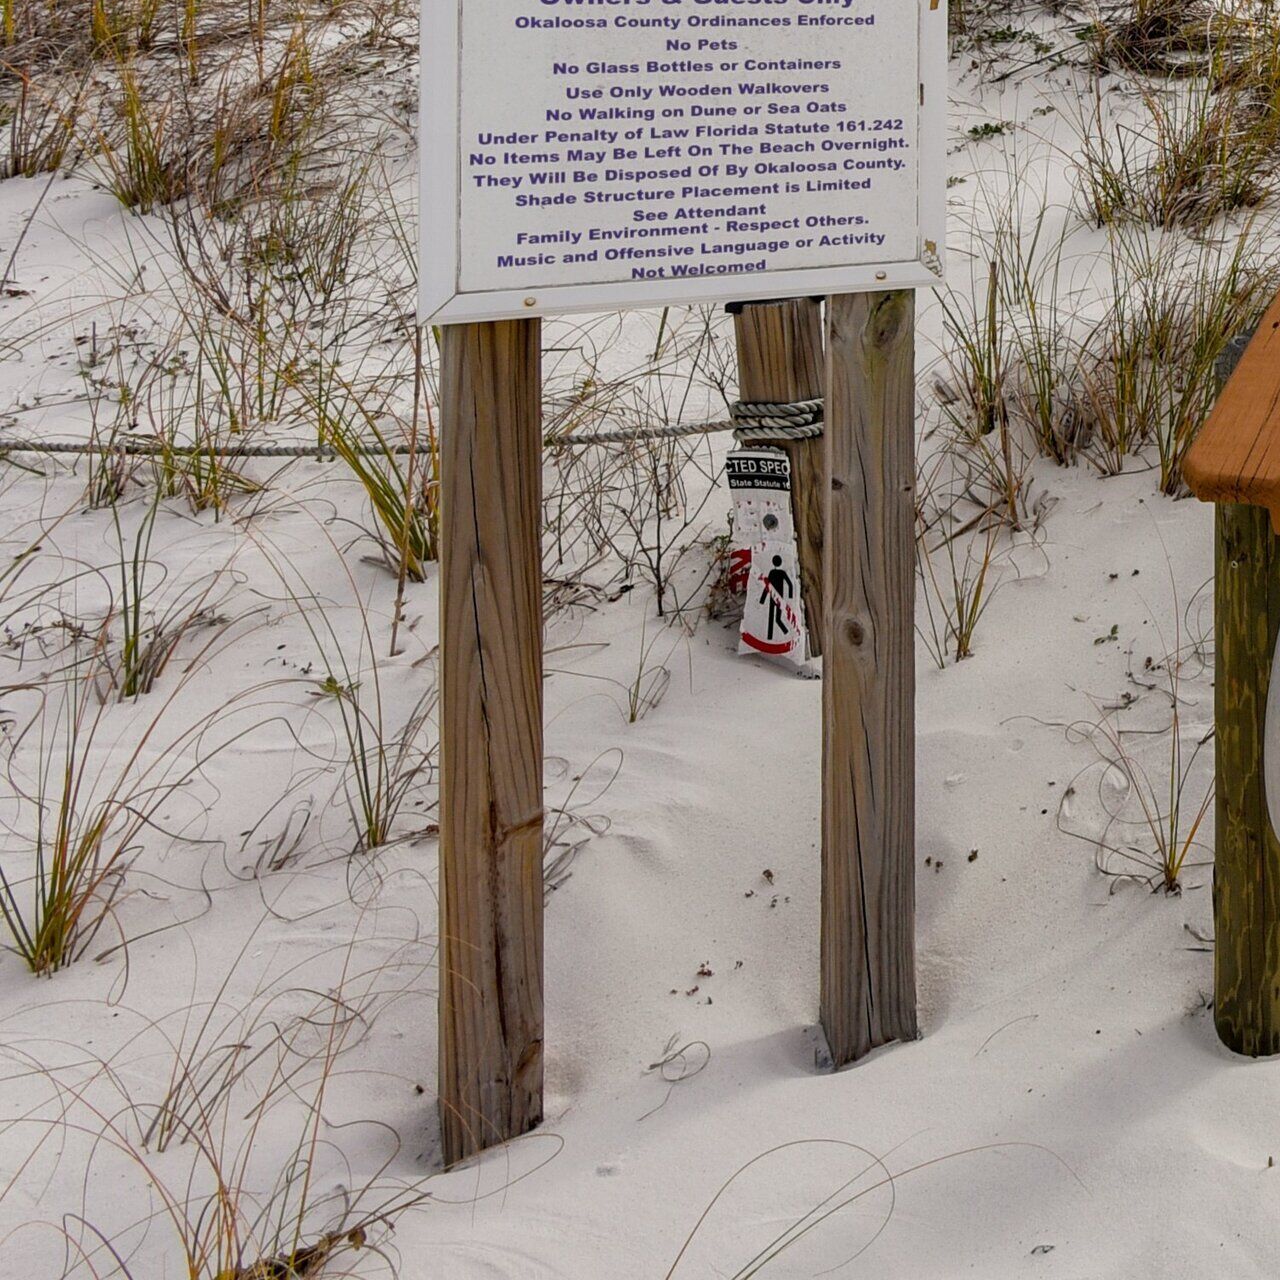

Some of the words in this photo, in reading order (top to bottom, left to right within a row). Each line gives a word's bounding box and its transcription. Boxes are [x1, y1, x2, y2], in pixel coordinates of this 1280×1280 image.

[515, 17, 608, 29] Okaloosa
[614, 16, 681, 31] County
[687, 16, 792, 28] Ordinances
[797, 15, 875, 26] Enforced
[666, 40, 692, 51] No
[697, 39, 738, 51] Pets
[553, 63, 580, 75] No
[585, 62, 640, 75] Glass
[646, 61, 714, 73] Bottles
[719, 63, 739, 72] or
[744, 59, 841, 71] Containers
[566, 88, 604, 100] Use
[609, 86, 653, 101] Only
[658, 85, 732, 97] Wooden
[738, 83, 830, 95] Walkovers
[546, 110, 573, 122] No
[578, 107, 655, 122] Walking
[661, 109, 684, 118] on
[690, 106, 737, 117] Dune
[743, 106, 762, 115] or
[767, 103, 801, 115] Sea
[806, 102, 847, 113] Oats
[478, 133, 539, 146] Under
[545, 130, 619, 144] Penalty
[624, 128, 644, 140] of
[650, 128, 690, 139] Law
[695, 125, 759, 138] Florida
[764, 123, 830, 135] Statute
[836, 119, 903, 133] 161.242
[469, 154, 496, 166] No
[503, 153, 560, 165] Items
[567, 150, 607, 164] May
[613, 148, 638, 160] Be
[644, 146, 682, 159] Left
[687, 145, 713, 157] On
[718, 144, 754, 156] The
[759, 141, 815, 154] Beach
[821, 138, 910, 152] Overnight.
[472, 175, 523, 189] They
[528, 172, 566, 185] Will
[573, 171, 598, 183] Be
[605, 167, 692, 183] Disposed
[698, 165, 719, 177] Of
[725, 165, 749, 178] By
[754, 162, 837, 175] Okaloosa
[843, 158, 906, 171] County.
[515, 193, 577, 207] Shade
[583, 190, 675, 204] Structure
[681, 183, 780, 199] Placement
[785, 182, 801, 193] is
[806, 178, 871, 192] Limited
[632, 210, 669, 222] See
[674, 205, 766, 220] Attendant
[516, 231, 582, 245] Family
[588, 223, 709, 241] Environment
[726, 218, 800, 233] Respect
[805, 216, 869, 228] Others.
[497, 254, 556, 268] Music
[562, 250, 598, 264] and
[604, 246, 695, 261] Offensive
[700, 241, 790, 255] Language
[795, 239, 814, 248] or
[818, 233, 886, 247] Activity
[631, 267, 666, 281] Not
[670, 260, 766, 277] Welcomed
[730, 478, 752, 487] State
[754, 479, 781, 488] Statute
